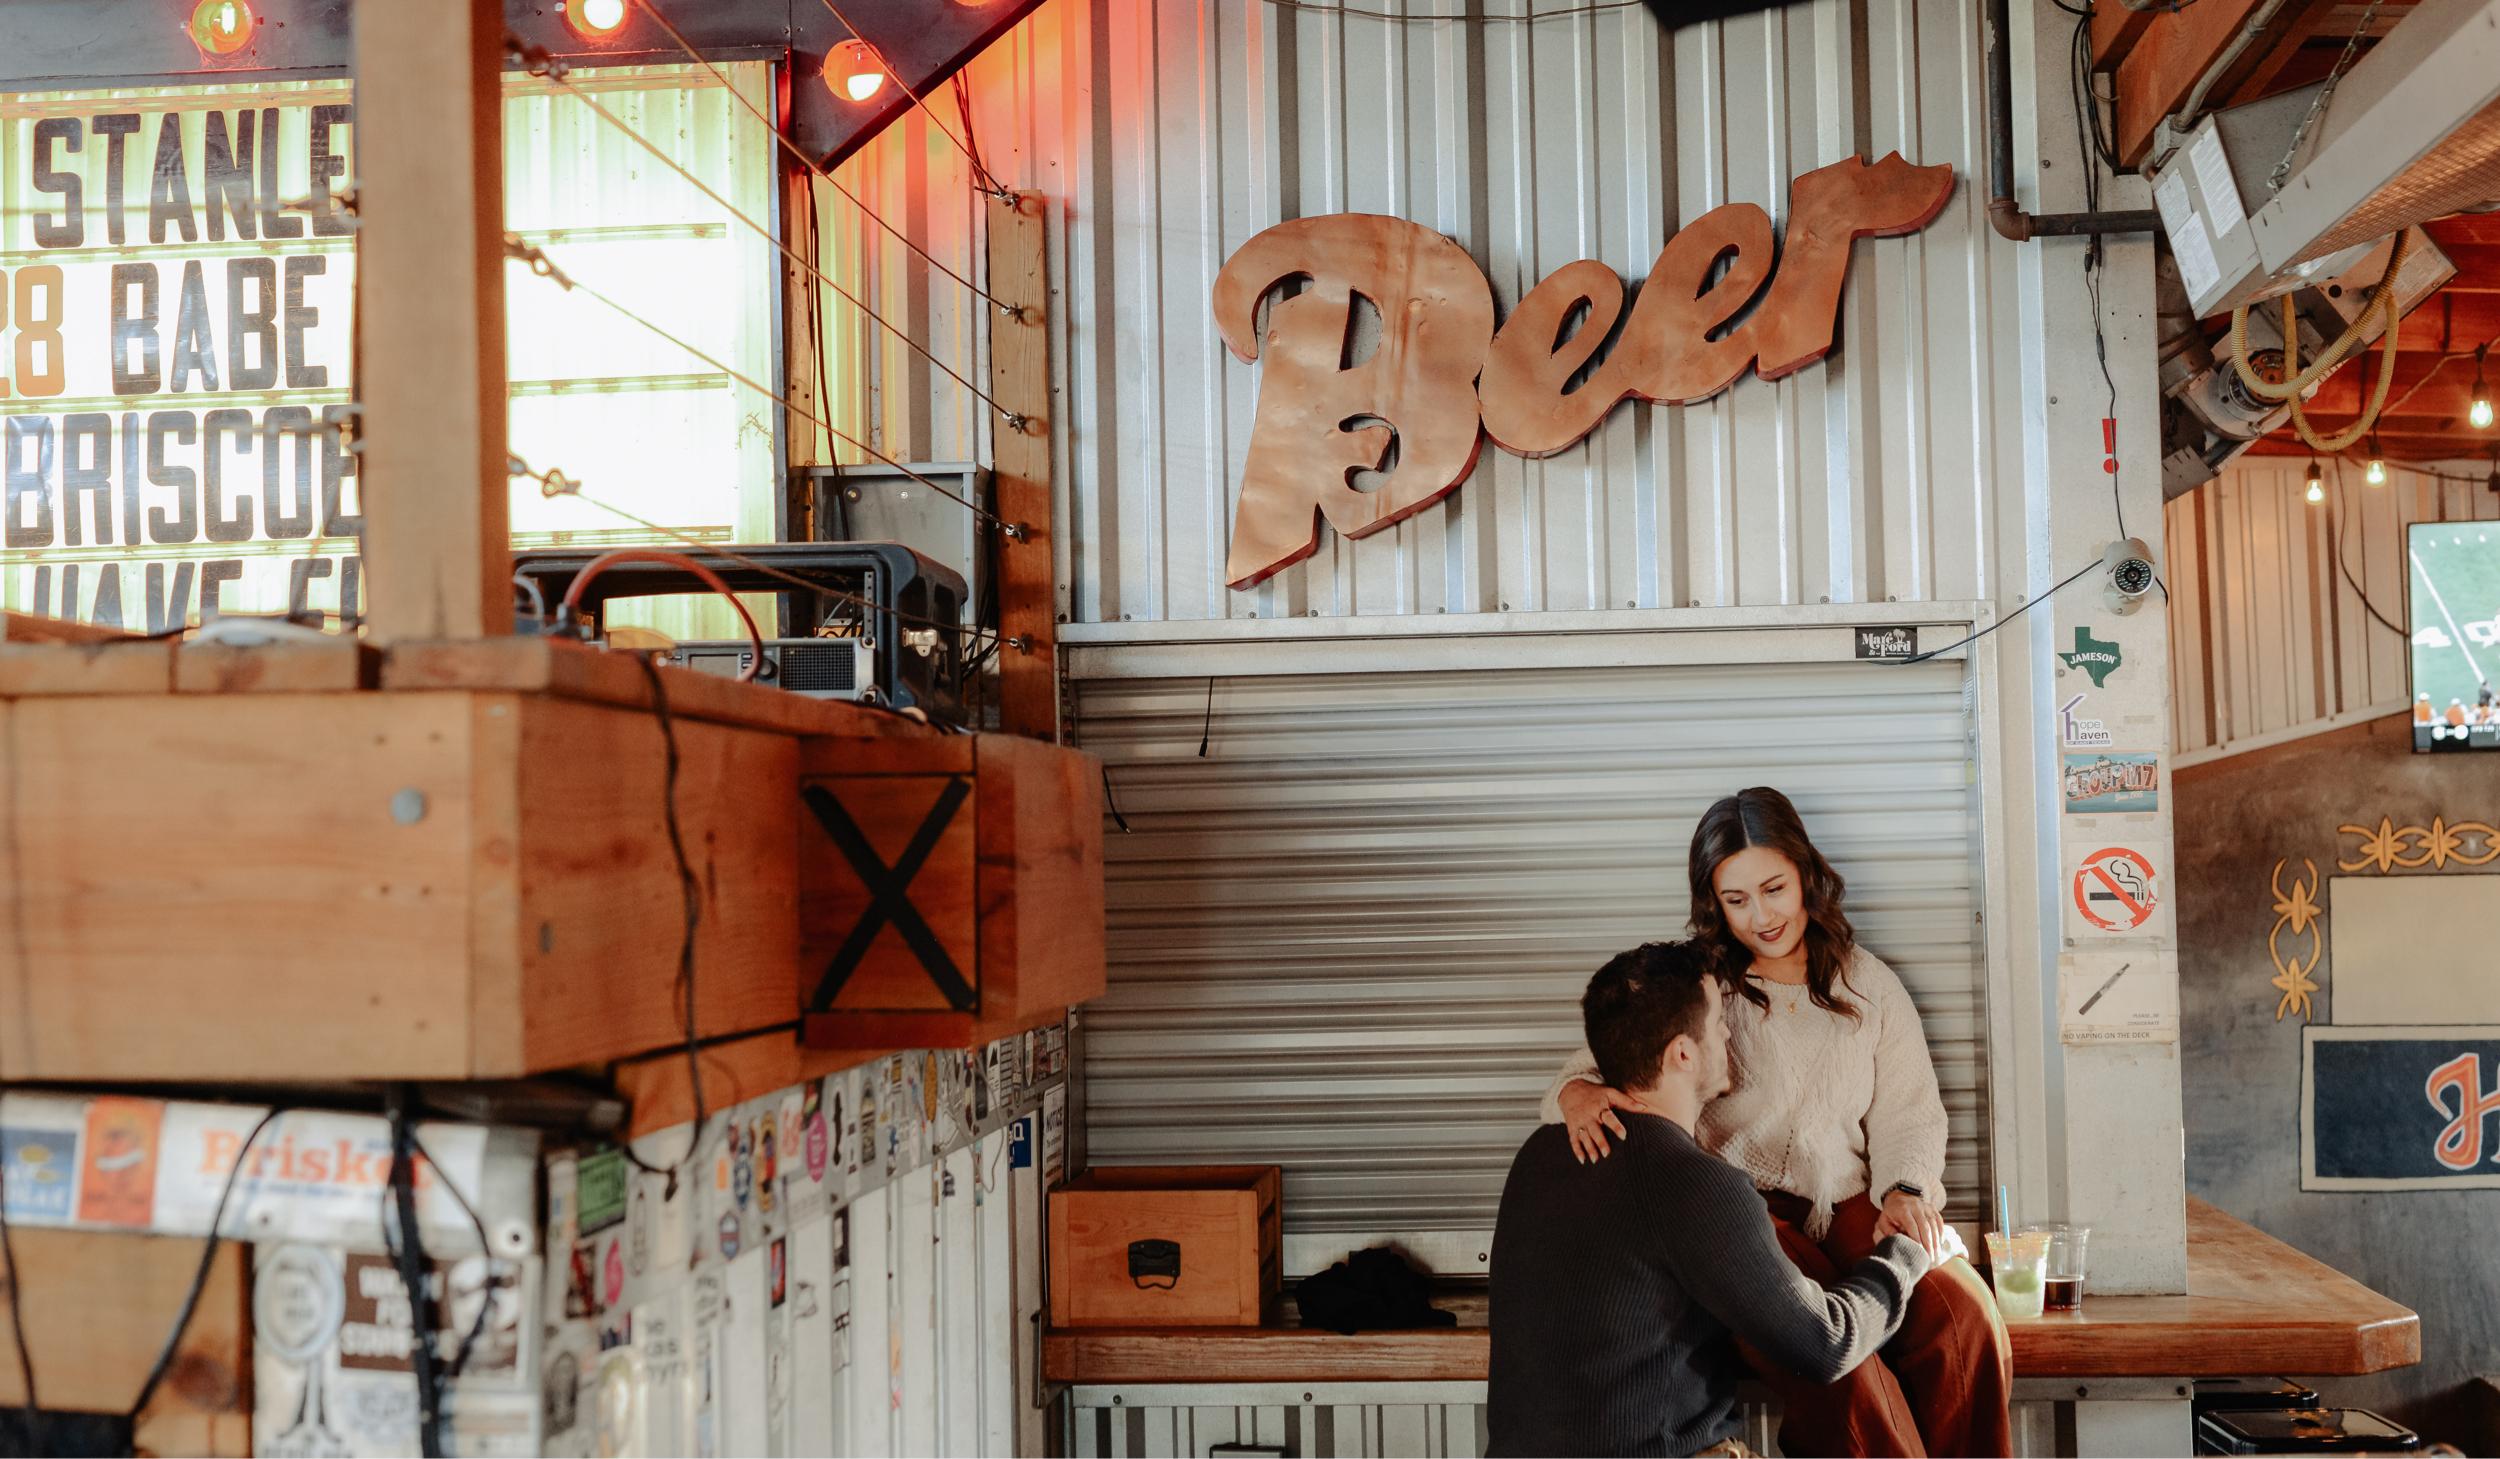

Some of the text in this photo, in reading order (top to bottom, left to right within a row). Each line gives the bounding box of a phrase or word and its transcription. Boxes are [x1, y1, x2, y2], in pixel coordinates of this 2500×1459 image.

[0, 254, 329, 397] 8 BABE
[1213, 149, 1954, 591] Beer
[1880, 640, 1911, 657] Ford
[2070, 652, 2116, 665] JAMESON
[2117, 1031, 2130, 1039] THE
